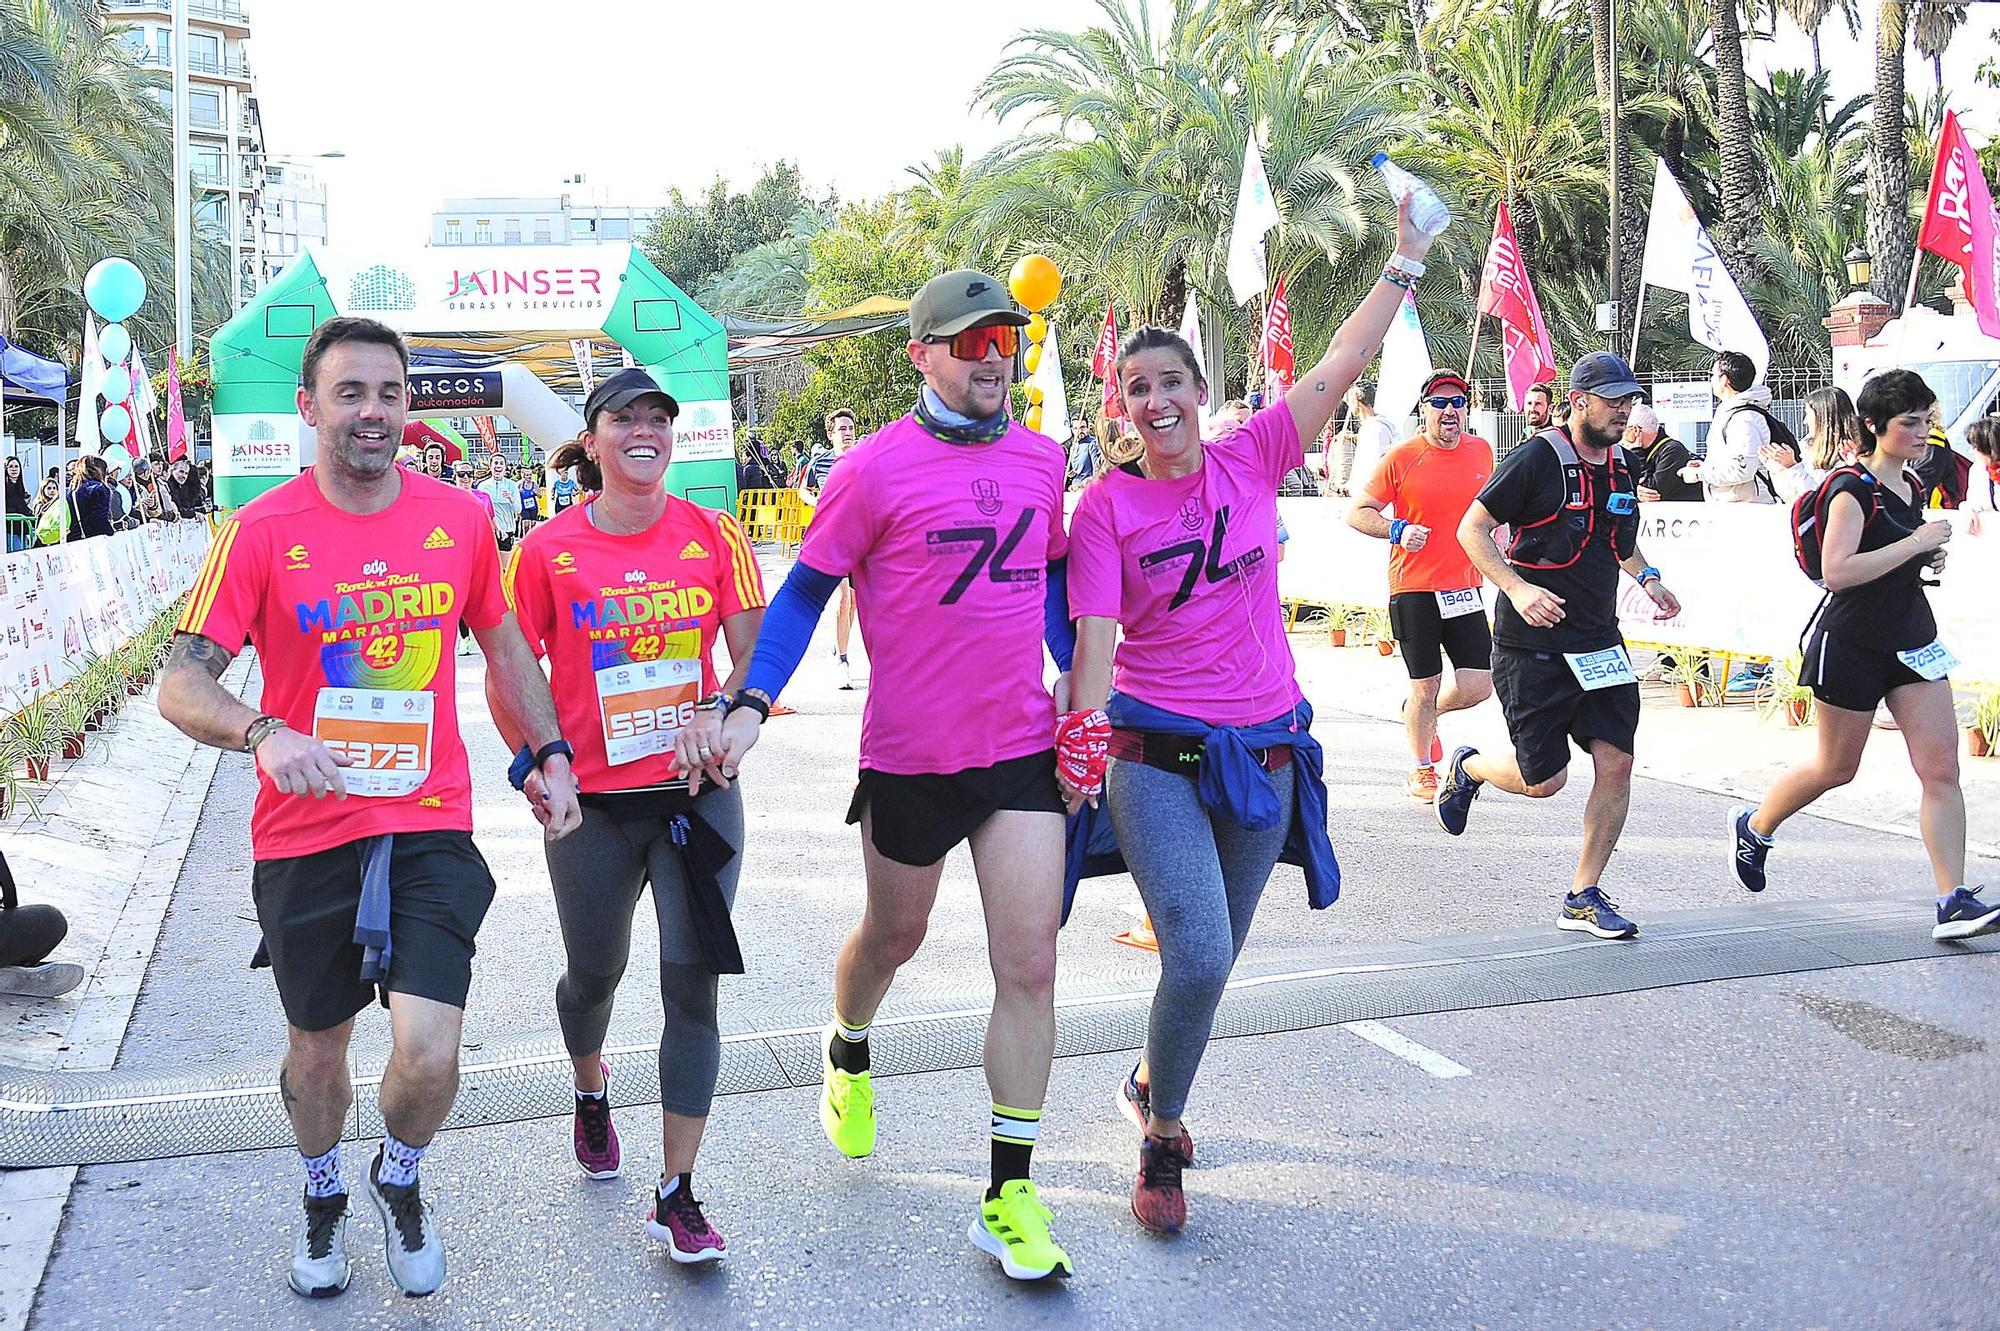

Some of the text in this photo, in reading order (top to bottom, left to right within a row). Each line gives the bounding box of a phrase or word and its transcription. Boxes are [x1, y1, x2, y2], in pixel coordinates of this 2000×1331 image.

[449, 269, 601, 296] JAINSER
[450, 302, 495, 310] OBRAS
[523, 300, 602, 309] SERVICIOS
[677, 429, 729, 443] JAINSER
[231, 444, 291, 456] JAINSER
[423, 539, 456, 550] adidas
[362, 558, 388, 577] edp
[295, 582, 455, 633] MADRID
[571, 586, 713, 630] MADRID
[1442, 591, 1473, 606] 1940
[322, 617, 441, 644] MARATHON
[589, 619, 700, 640] MARATHON
[366, 635, 399, 658] 42
[631, 634, 660, 655] 42
[1579, 660, 1629, 681] 2544
[610, 700, 696, 739] 5386
